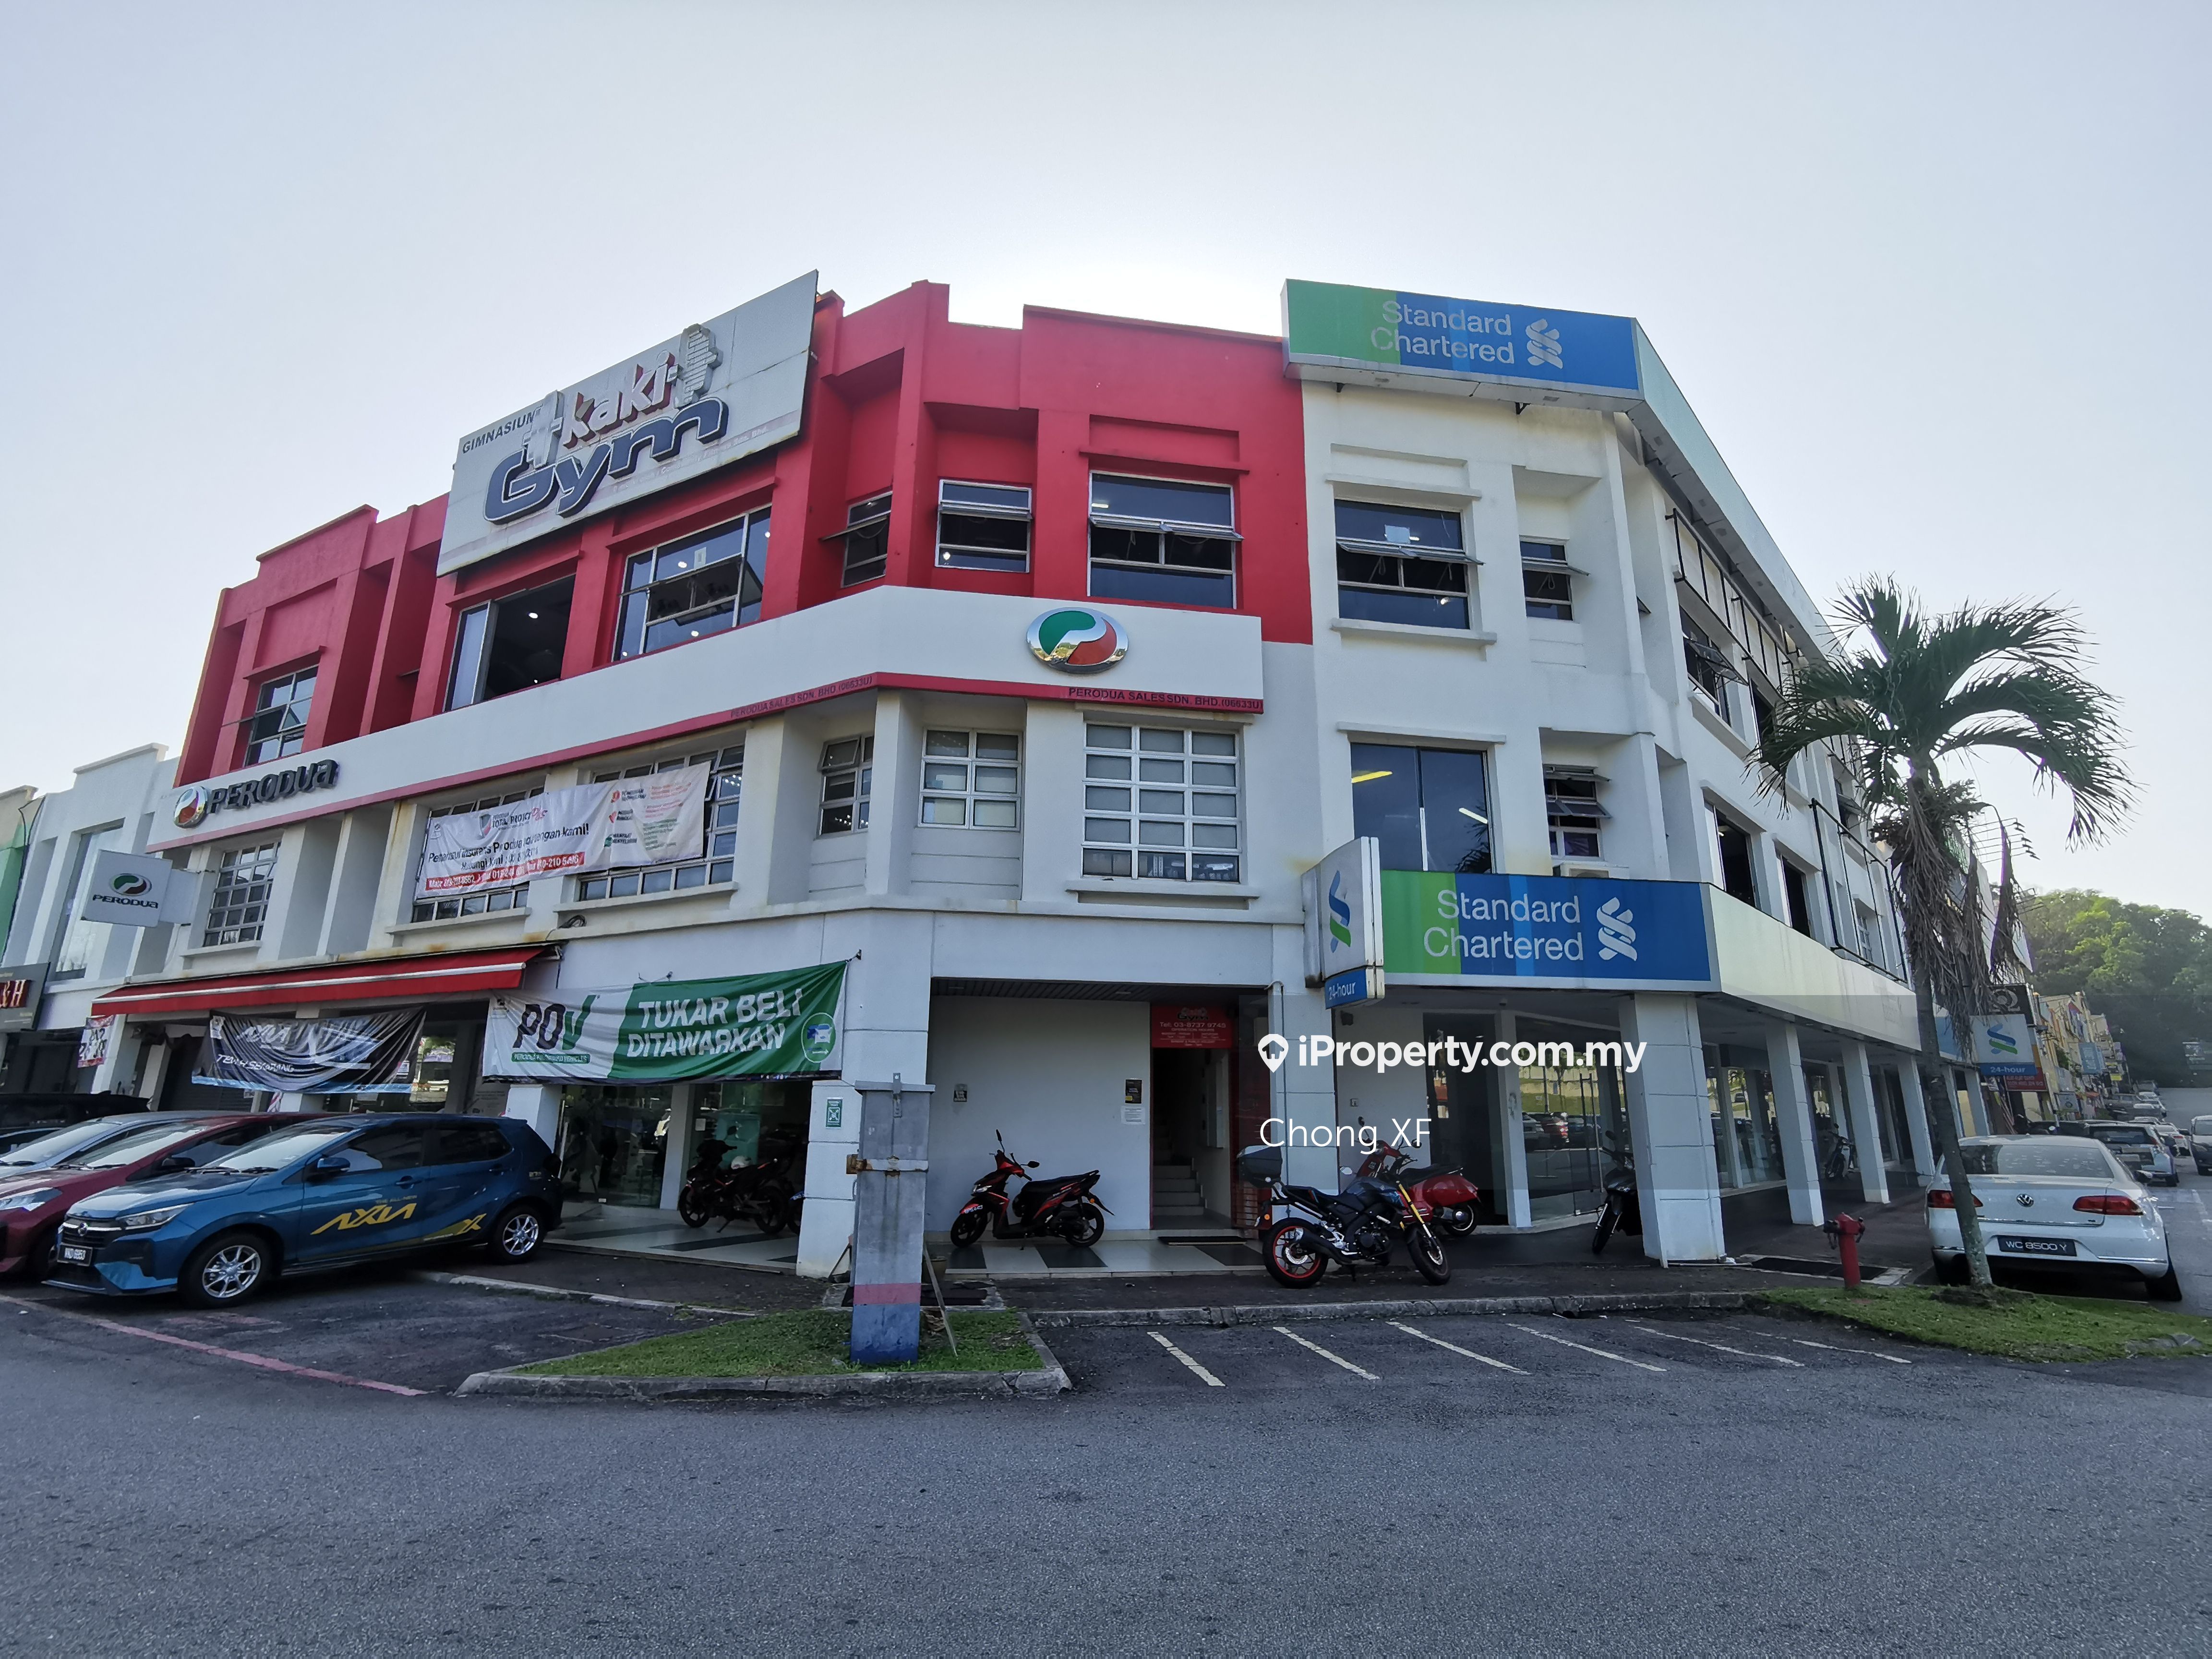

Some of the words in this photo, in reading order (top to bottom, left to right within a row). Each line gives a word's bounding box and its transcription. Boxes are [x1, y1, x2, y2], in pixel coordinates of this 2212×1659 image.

[1382, 300, 1513, 336] Standard
[1370, 326, 1515, 365] Chartered
[483, 397, 729, 525] Gym
[1069, 687, 1126, 700] PERODUA
[1128, 692, 1166, 703] SALES
[1437, 890, 1580, 924] Standard
[1423, 926, 1584, 961] Chartered
[512, 994, 597, 1050] POV
[638, 996, 729, 1029] TUKAR
[736, 988, 804, 1023] BELI
[627, 1022, 786, 1058] DITAWARKAN
[2025, 1242, 2058, 1250] 8500
